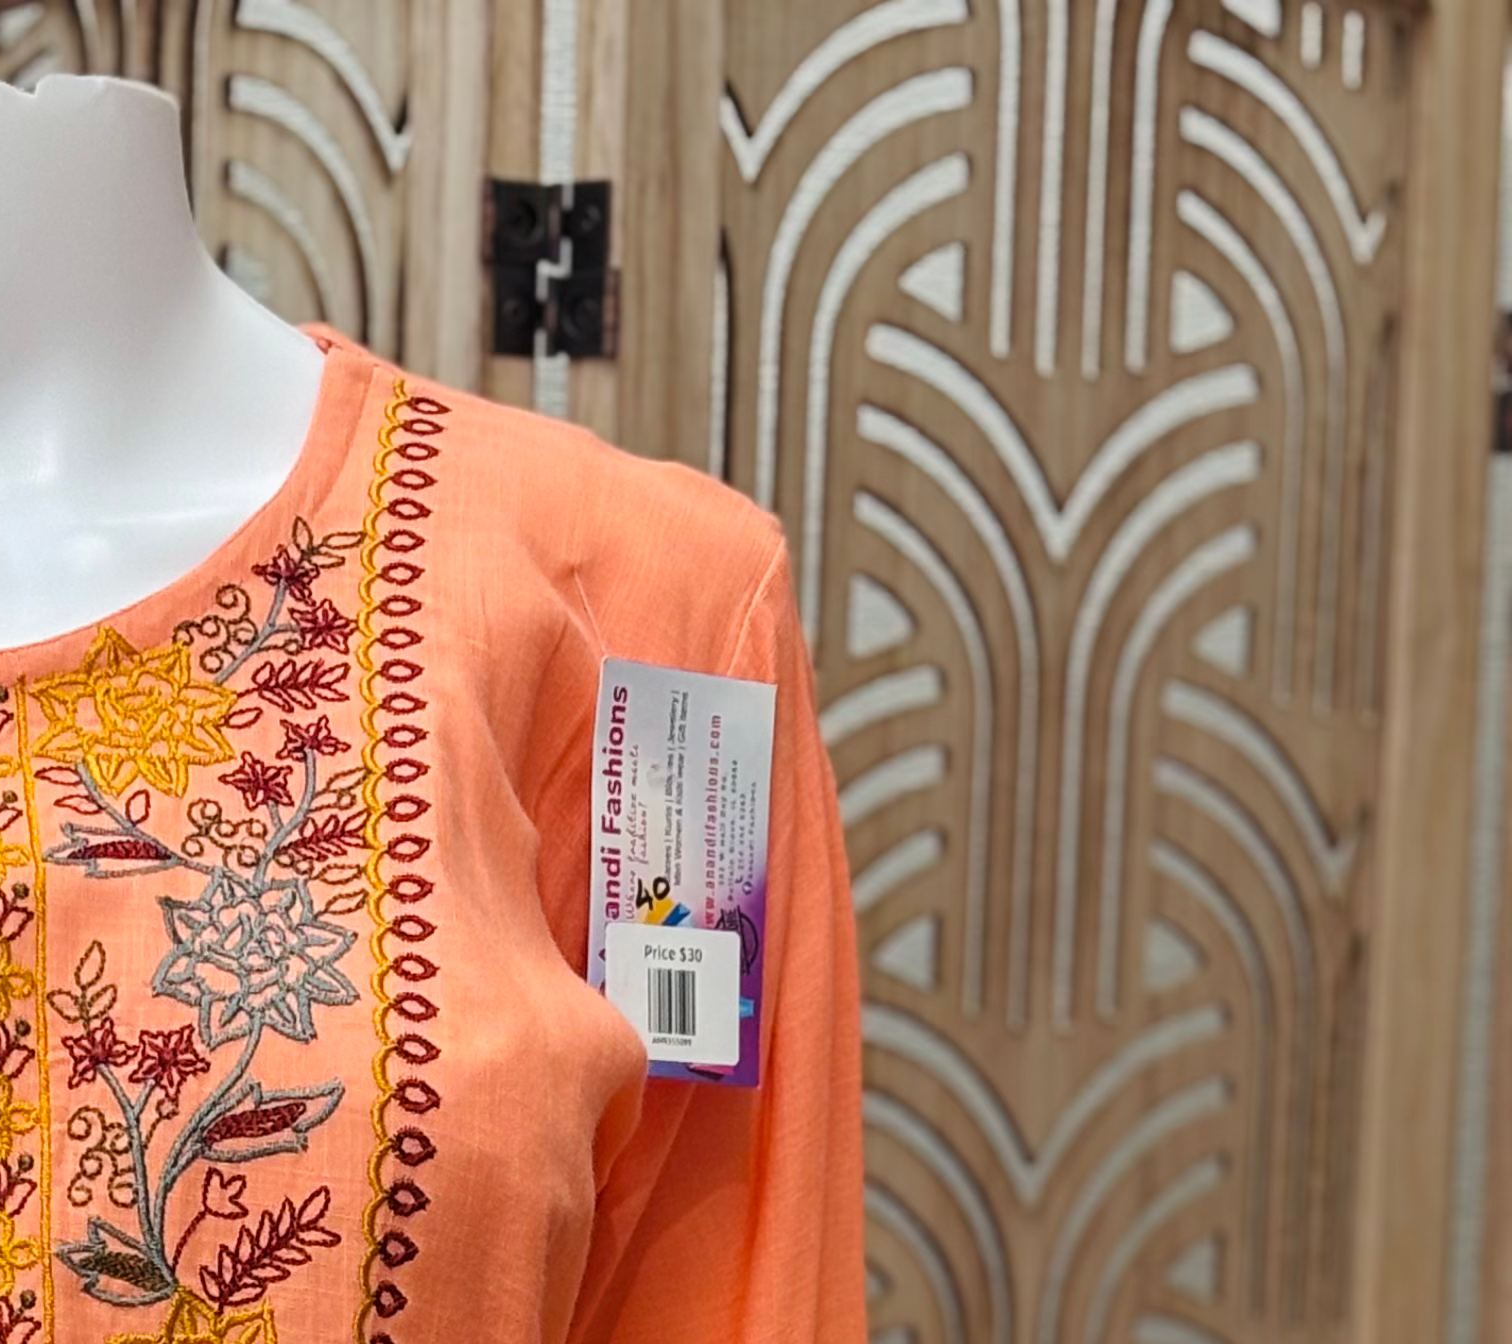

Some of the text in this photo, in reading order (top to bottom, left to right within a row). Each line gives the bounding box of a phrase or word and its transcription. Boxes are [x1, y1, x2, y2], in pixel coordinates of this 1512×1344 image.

[600, 685, 628, 920] andi Fashions
[703, 714, 722, 926] ww.anandifashions.com
[644, 943, 703, 963] Price $30
